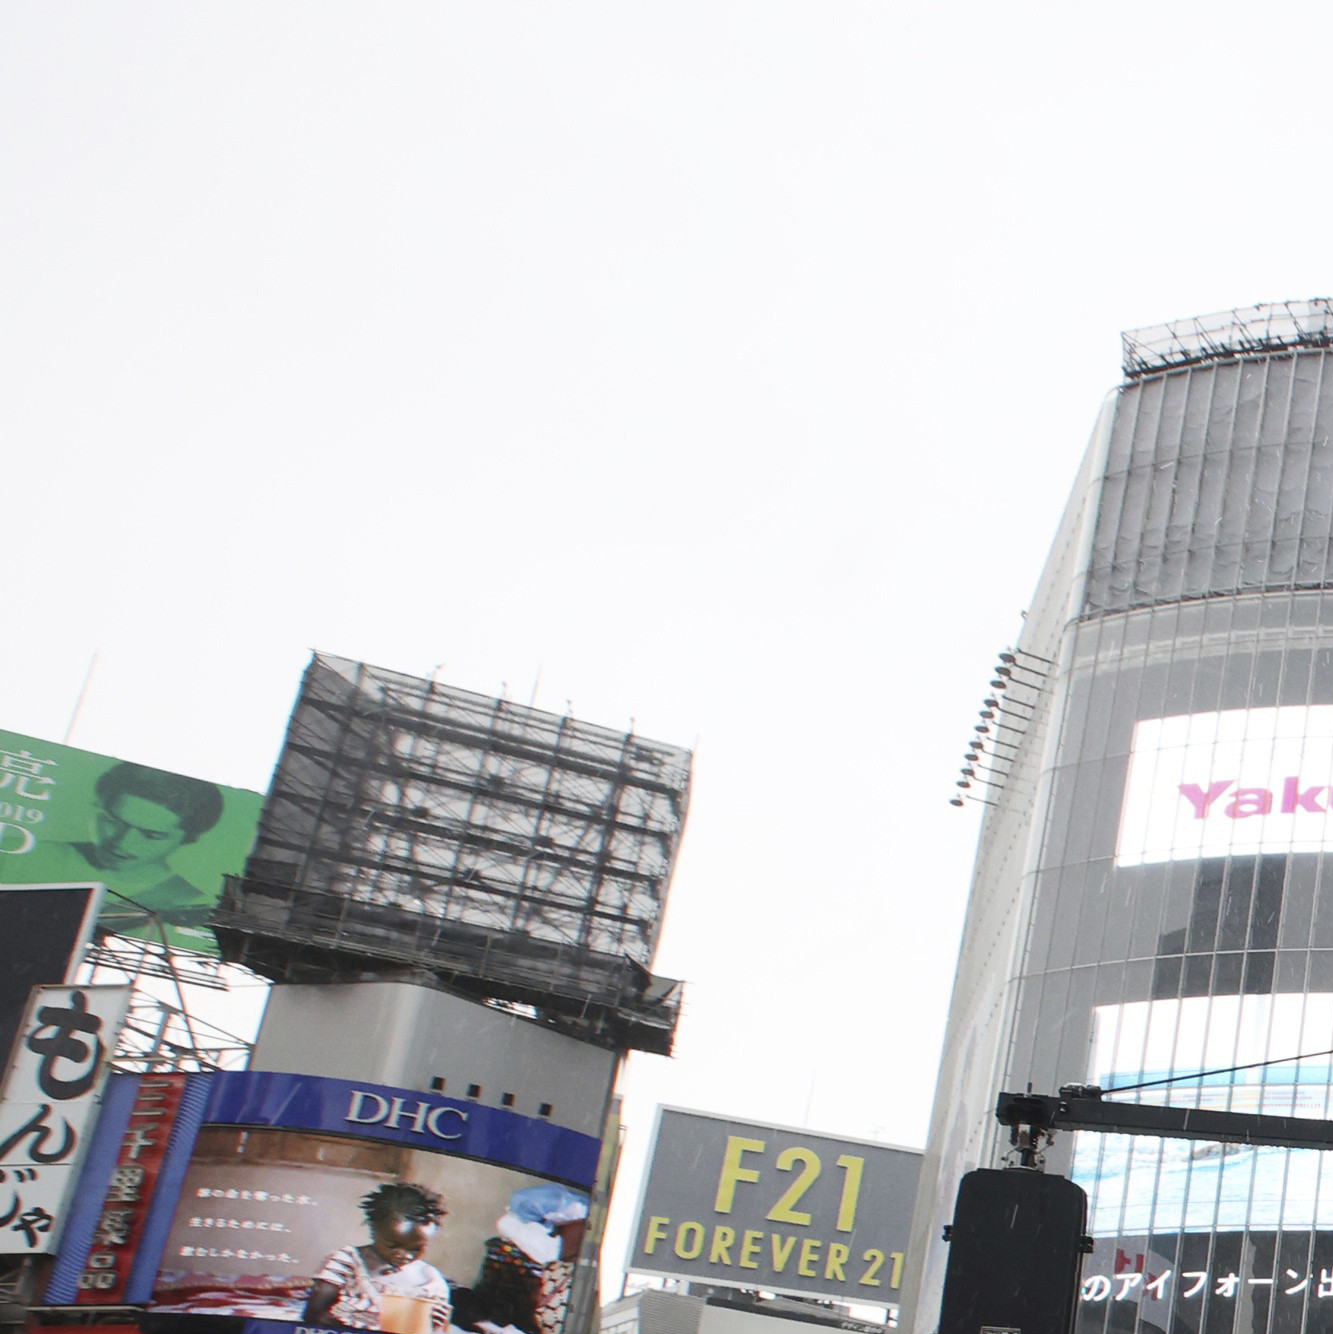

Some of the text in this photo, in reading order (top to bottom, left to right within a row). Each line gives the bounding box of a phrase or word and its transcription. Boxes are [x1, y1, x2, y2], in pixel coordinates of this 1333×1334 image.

[345, 1090, 469, 1140] DHC
[713, 1135, 864, 1233] F21
[643, 1216, 905, 1290] FOREVER 21
